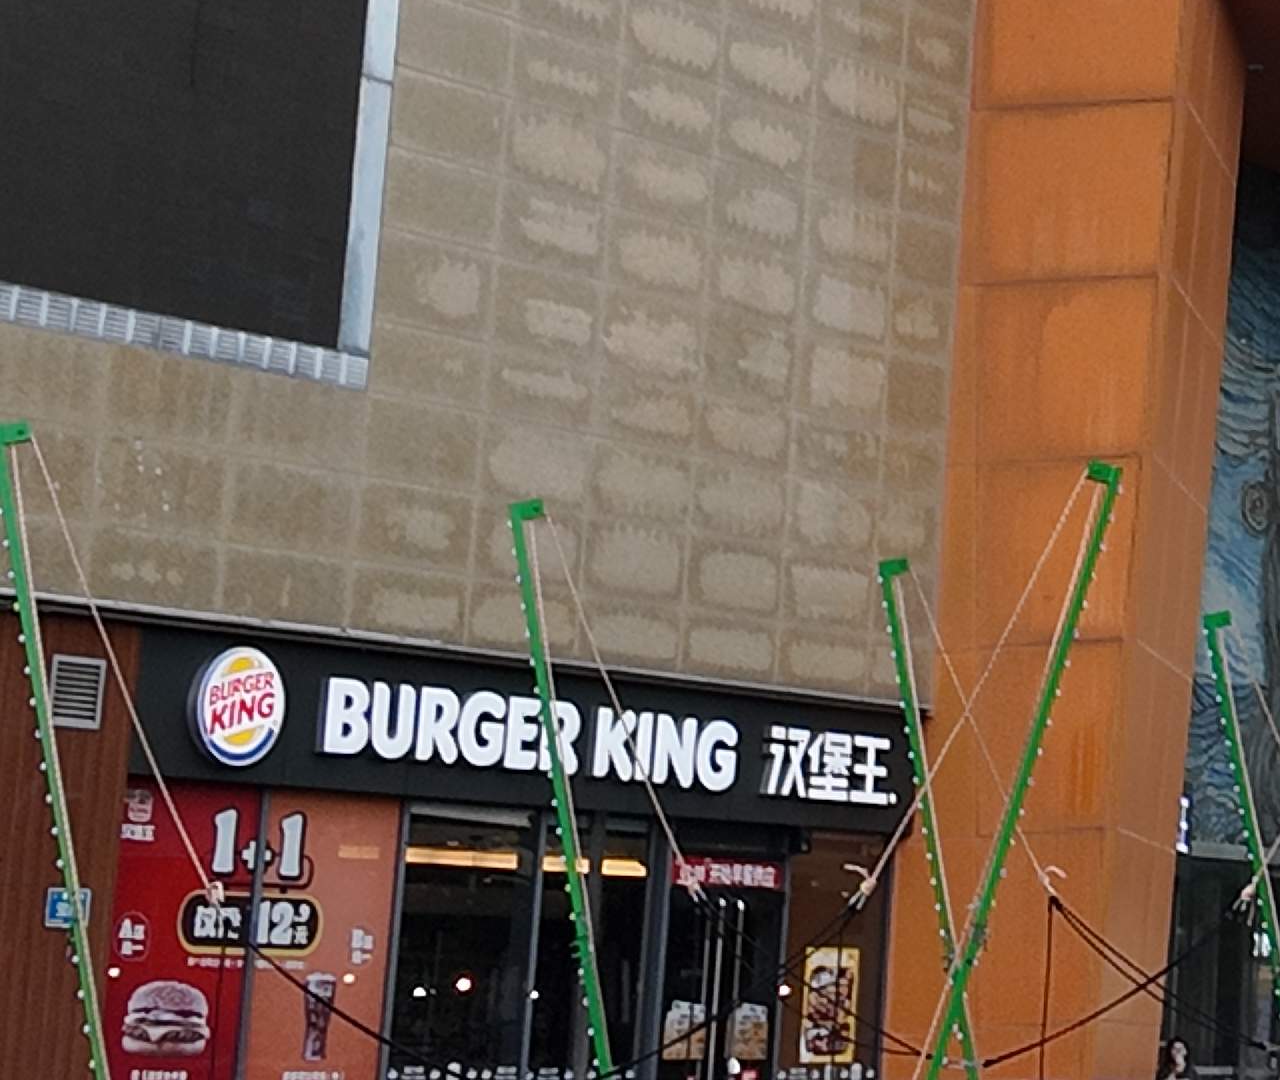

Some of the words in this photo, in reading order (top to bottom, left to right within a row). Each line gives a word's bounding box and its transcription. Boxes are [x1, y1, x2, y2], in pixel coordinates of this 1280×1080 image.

[208, 692, 275, 736] KING
[209, 671, 275, 705] BURGER
[322, 676, 581, 775] BURGER
[592, 706, 738, 792] KING
[765, 724, 891, 805] 汉堡王
[212, 808, 304, 878] 1+1
